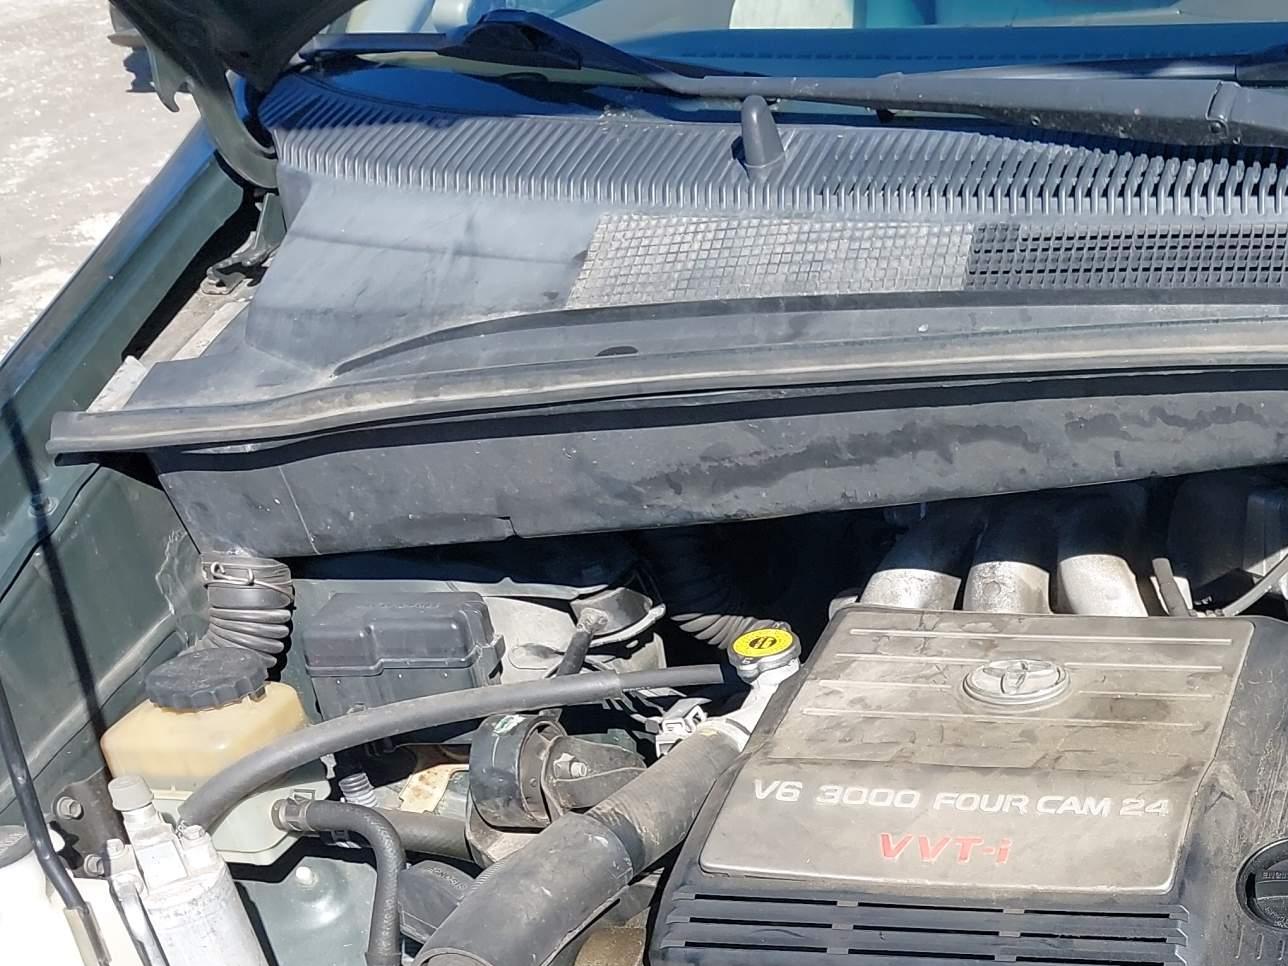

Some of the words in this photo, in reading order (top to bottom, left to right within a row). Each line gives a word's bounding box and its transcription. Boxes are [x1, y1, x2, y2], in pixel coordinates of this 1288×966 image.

[754, 779, 803, 802] V6
[815, 784, 921, 809] 3000
[933, 792, 1029, 815] FOUR
[1036, 795, 1112, 817] CAM
[1119, 797, 1169, 816] 24
[880, 832, 1012, 864] VVT-i
